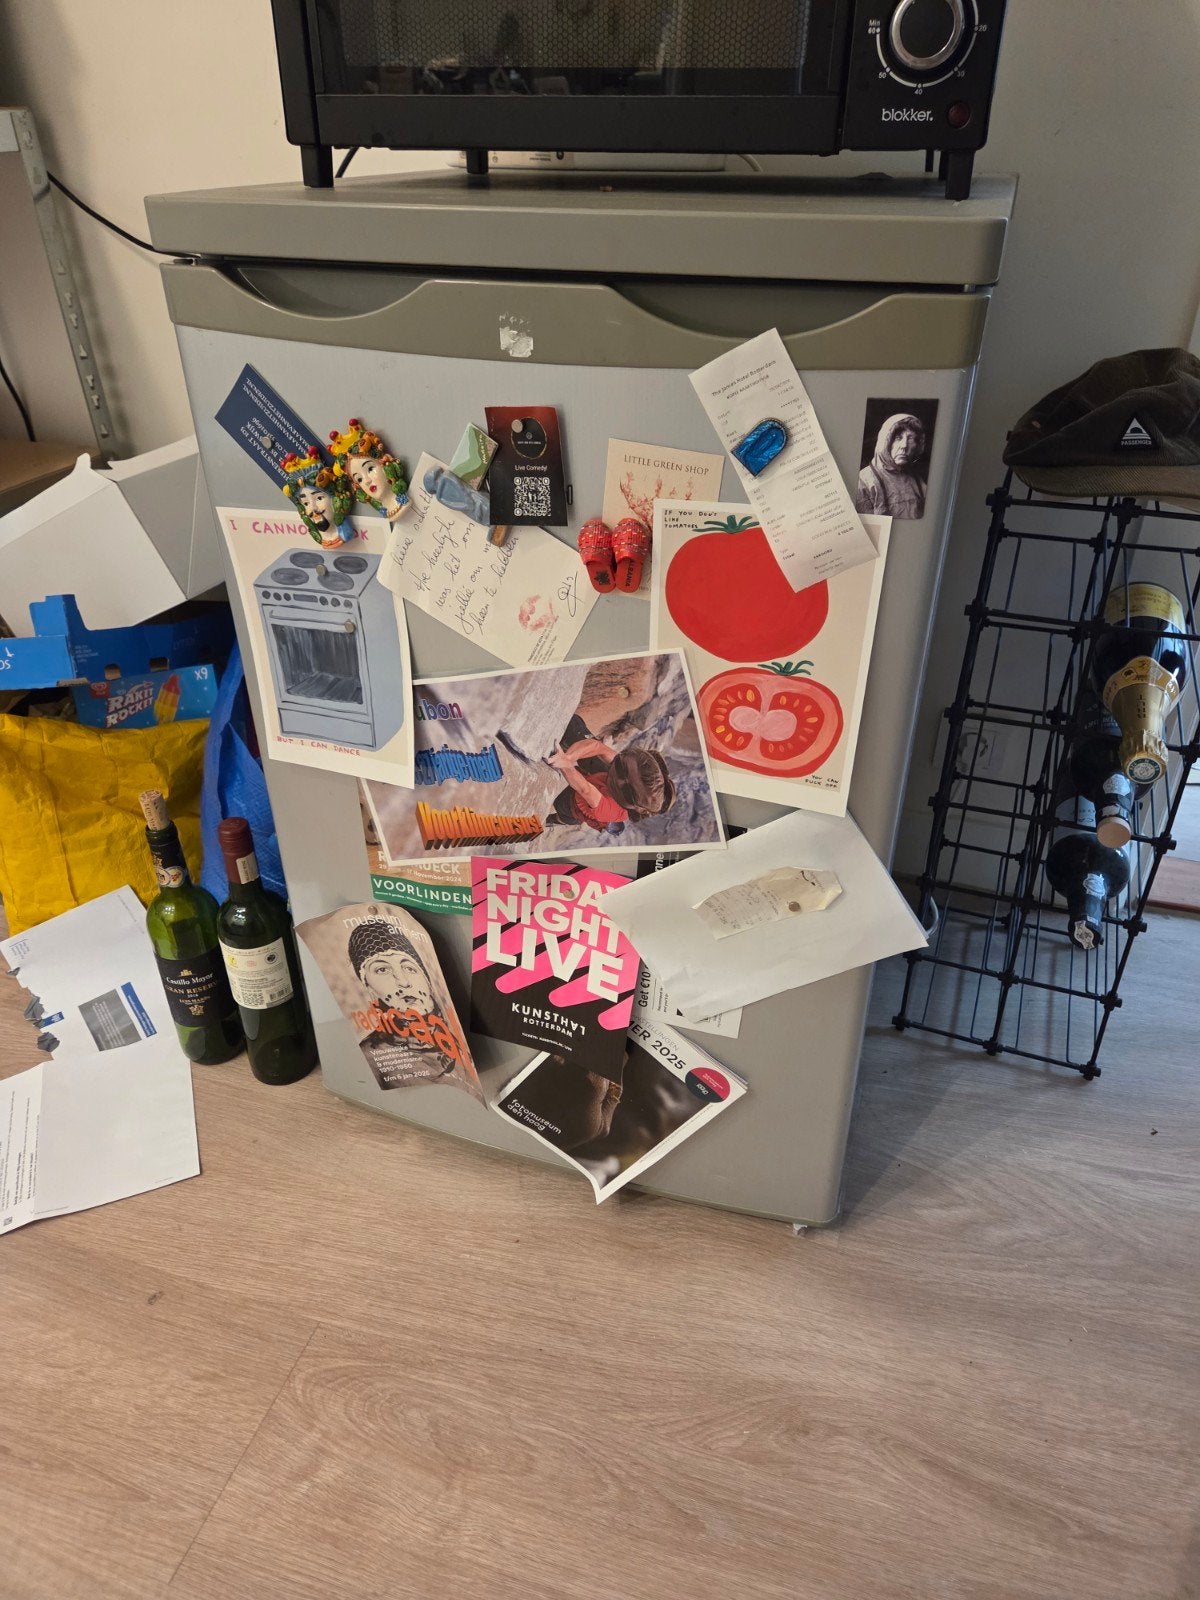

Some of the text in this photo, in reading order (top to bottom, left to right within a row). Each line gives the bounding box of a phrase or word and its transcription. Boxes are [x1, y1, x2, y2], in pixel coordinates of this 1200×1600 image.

[881, 108, 934, 122] blokker.
[623, 454, 710, 476] LITTLE GREEN SHOP
[229, 519, 238, 531] I
[251, 521, 308, 536] CANNO
[275, 735, 294, 744] BUT
[309, 740, 328, 749] CAN
[332, 745, 361, 756] DANCE
[373, 878, 472, 905] VOORLINDEN
[343, 913, 403, 929] museum
[486, 891, 621, 954] NIGHT
[388, 921, 429, 945] arnhem
[486, 921, 624, 1003] LIVE
[637, 989, 649, 1008] Get
[523, 1016, 574, 1038] ROTTERDAM
[373, 1052, 414, 1061] kunstenaars
[383, 1057, 422, 1066] modernisme
[648, 1038, 688, 1071] 2025
[505, 1103, 547, 1132] den haag
[511, 1098, 562, 1135] fotomuseum
